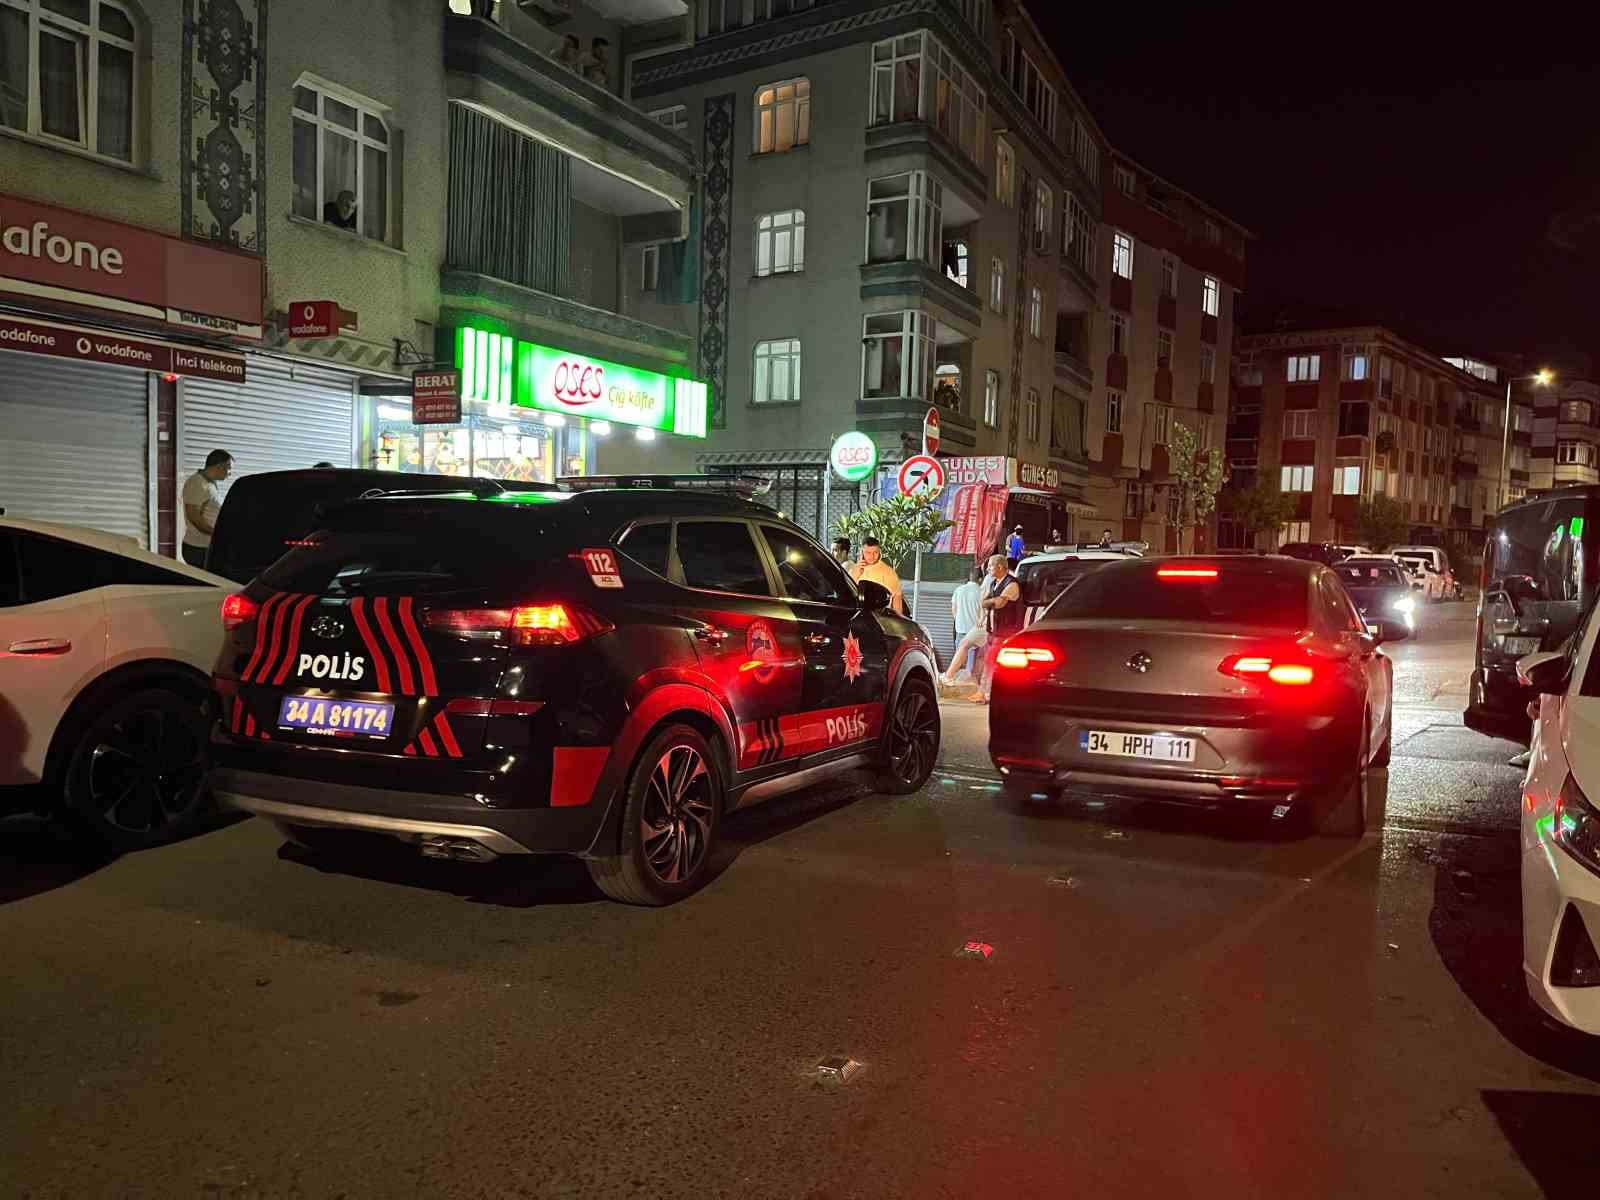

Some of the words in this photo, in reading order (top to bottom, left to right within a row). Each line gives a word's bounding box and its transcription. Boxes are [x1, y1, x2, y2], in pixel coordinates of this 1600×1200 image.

[291, 324, 327, 334] vodafone
[95, 343, 152, 361] vodafone
[200, 358, 243, 375] telekom
[415, 374, 456, 388] BERAT
[588, 553, 616, 572] 112
[297, 651, 365, 681] POLİS
[286, 700, 309, 723] 34
[311, 703, 325, 725] A
[329, 705, 387, 731] 81174
[826, 709, 866, 743] POLİS
[1090, 733, 1109, 751] 34
[1122, 736, 1153, 756] HPH
[1168, 740, 1190, 758] 111
